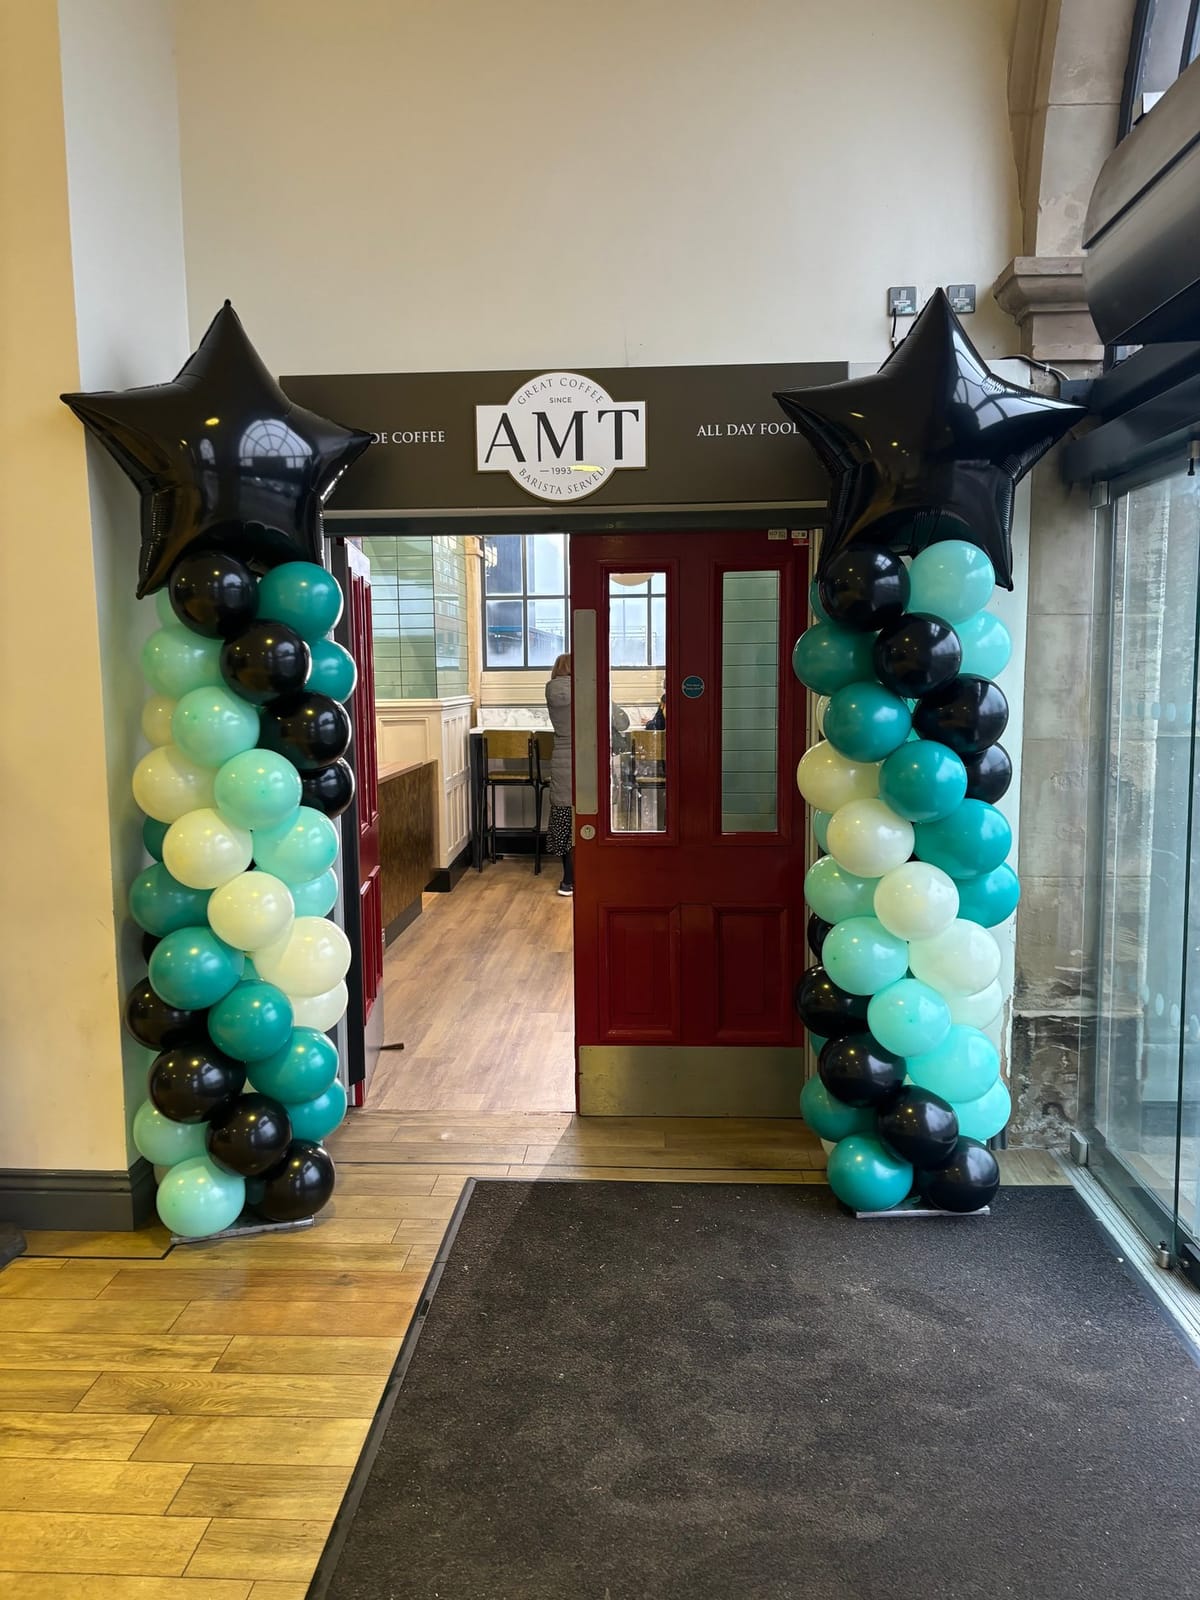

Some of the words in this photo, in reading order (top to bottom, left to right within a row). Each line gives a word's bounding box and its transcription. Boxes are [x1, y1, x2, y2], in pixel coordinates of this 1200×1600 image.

[517, 378, 554, 405] GREAT
[559, 377, 604, 404] COFFEE
[549, 396, 572, 404] SINCE
[392, 430, 445, 444] COFFEE
[484, 408, 640, 463] AMT
[696, 424, 723, 437] ALL
[726, 423, 756, 436] DAY
[551, 466, 572, 475] 1993
[518, 468, 563, 495] BARISTA
[567, 466, 606, 495] SERVED
